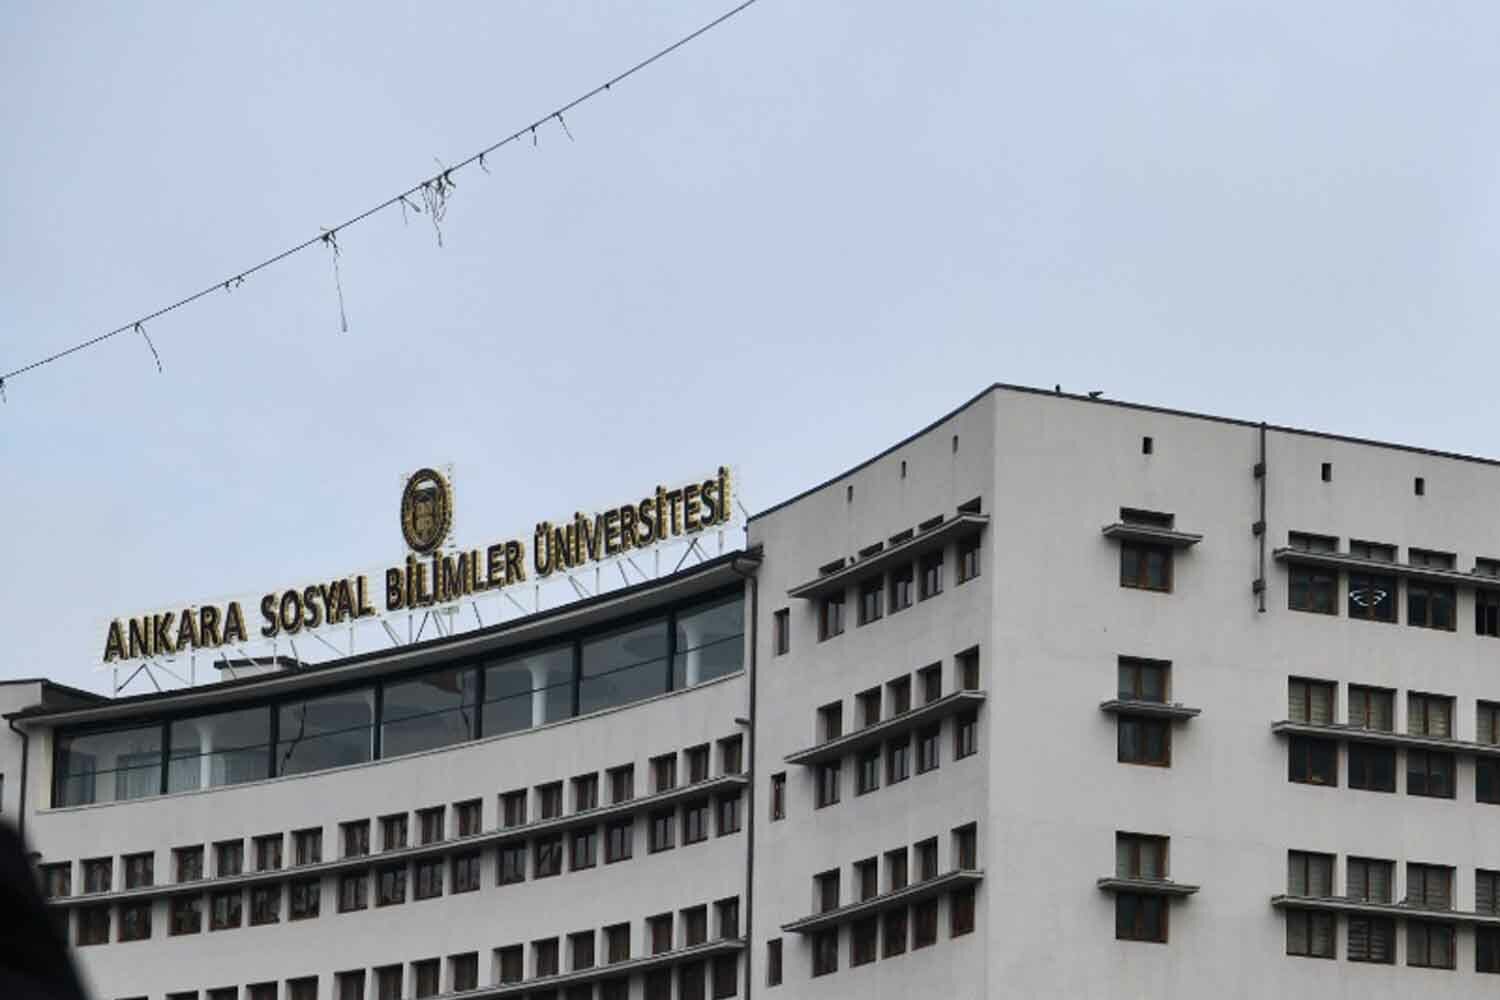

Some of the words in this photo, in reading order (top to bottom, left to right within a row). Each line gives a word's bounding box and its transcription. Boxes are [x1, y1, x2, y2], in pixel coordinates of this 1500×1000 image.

[103, 600, 248, 663] ANKARA
[260, 573, 376, 638] SOSYAL
[385, 539, 526, 611] BİLİMLER
[533, 465, 733, 575] ÜNİVERSİTESİ
